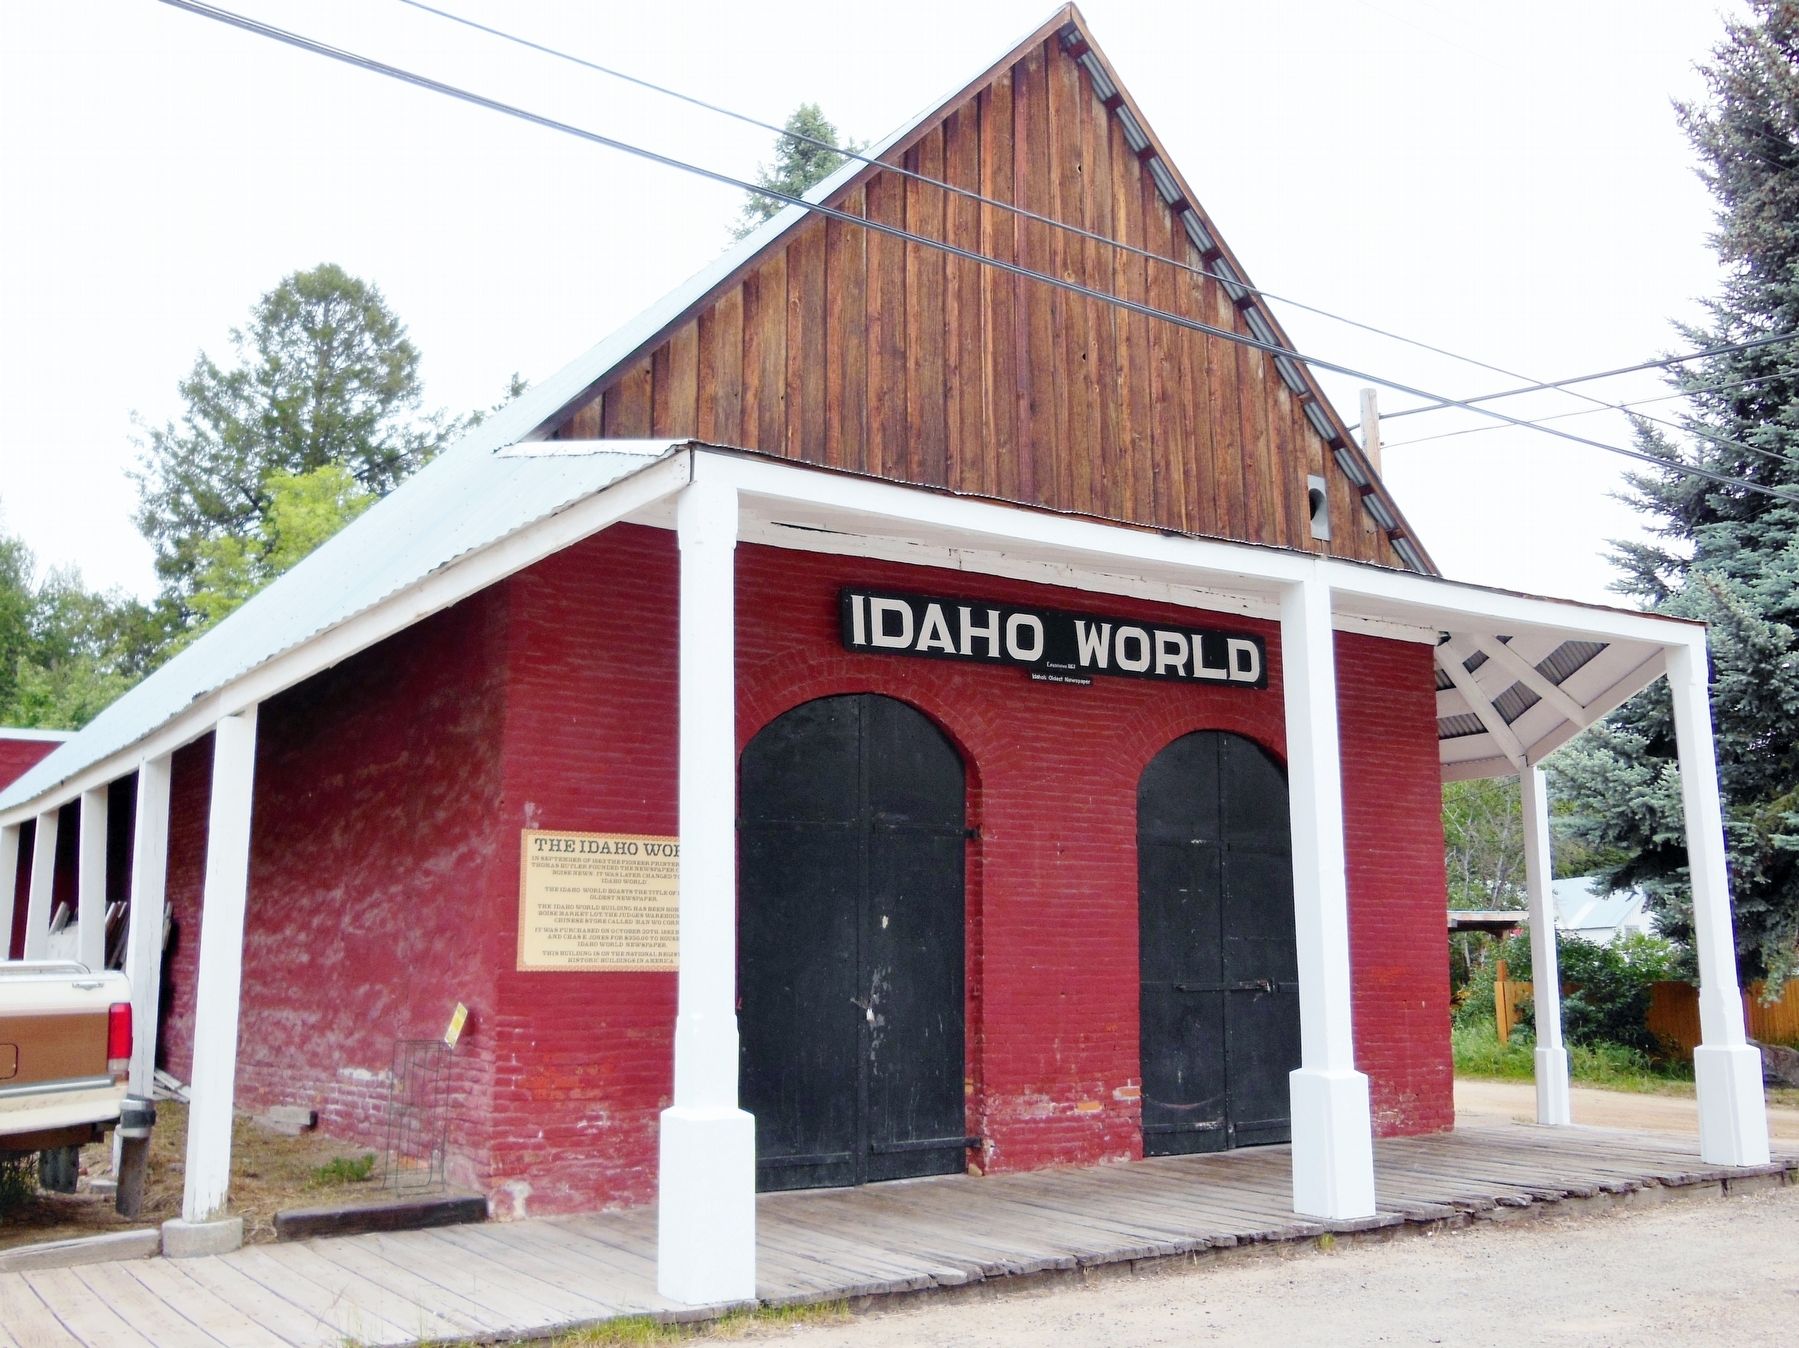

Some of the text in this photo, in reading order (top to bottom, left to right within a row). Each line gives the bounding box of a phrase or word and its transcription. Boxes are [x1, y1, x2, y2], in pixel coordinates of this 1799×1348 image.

[850, 594, 1260, 684] IDAHO WORLD
[1064, 677, 1091, 685] Newspaper
[534, 838, 575, 852] THE
[579, 840, 638, 855] IDAHO
